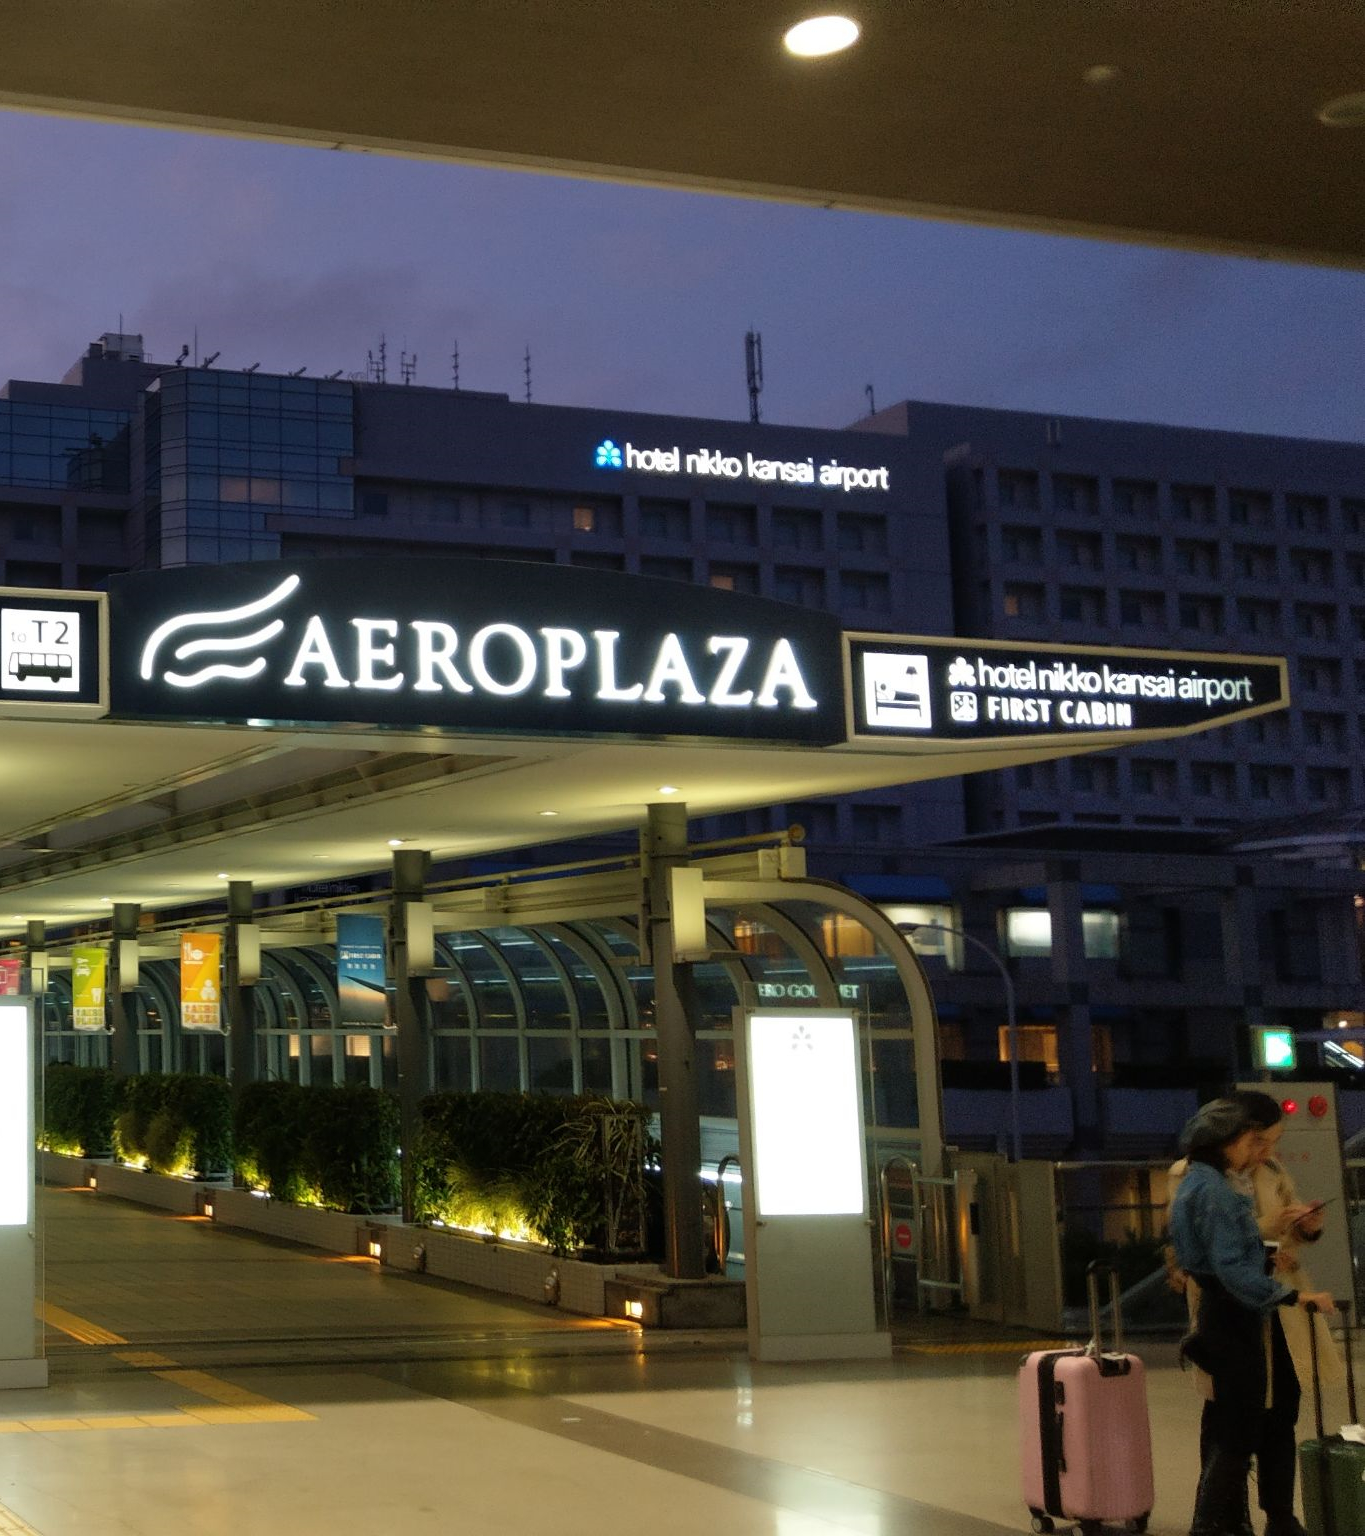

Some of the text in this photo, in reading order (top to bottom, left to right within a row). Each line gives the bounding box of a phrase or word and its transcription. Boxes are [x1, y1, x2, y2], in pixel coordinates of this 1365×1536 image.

[626, 442, 890, 491] hotel nikko kansai airport
[11, 631, 27, 642] to
[284, 614, 818, 708] AEROPLAZA
[977, 657, 1253, 706] hotel nikko kansai airport
[987, 696, 1132, 727] FIRST CABIN
